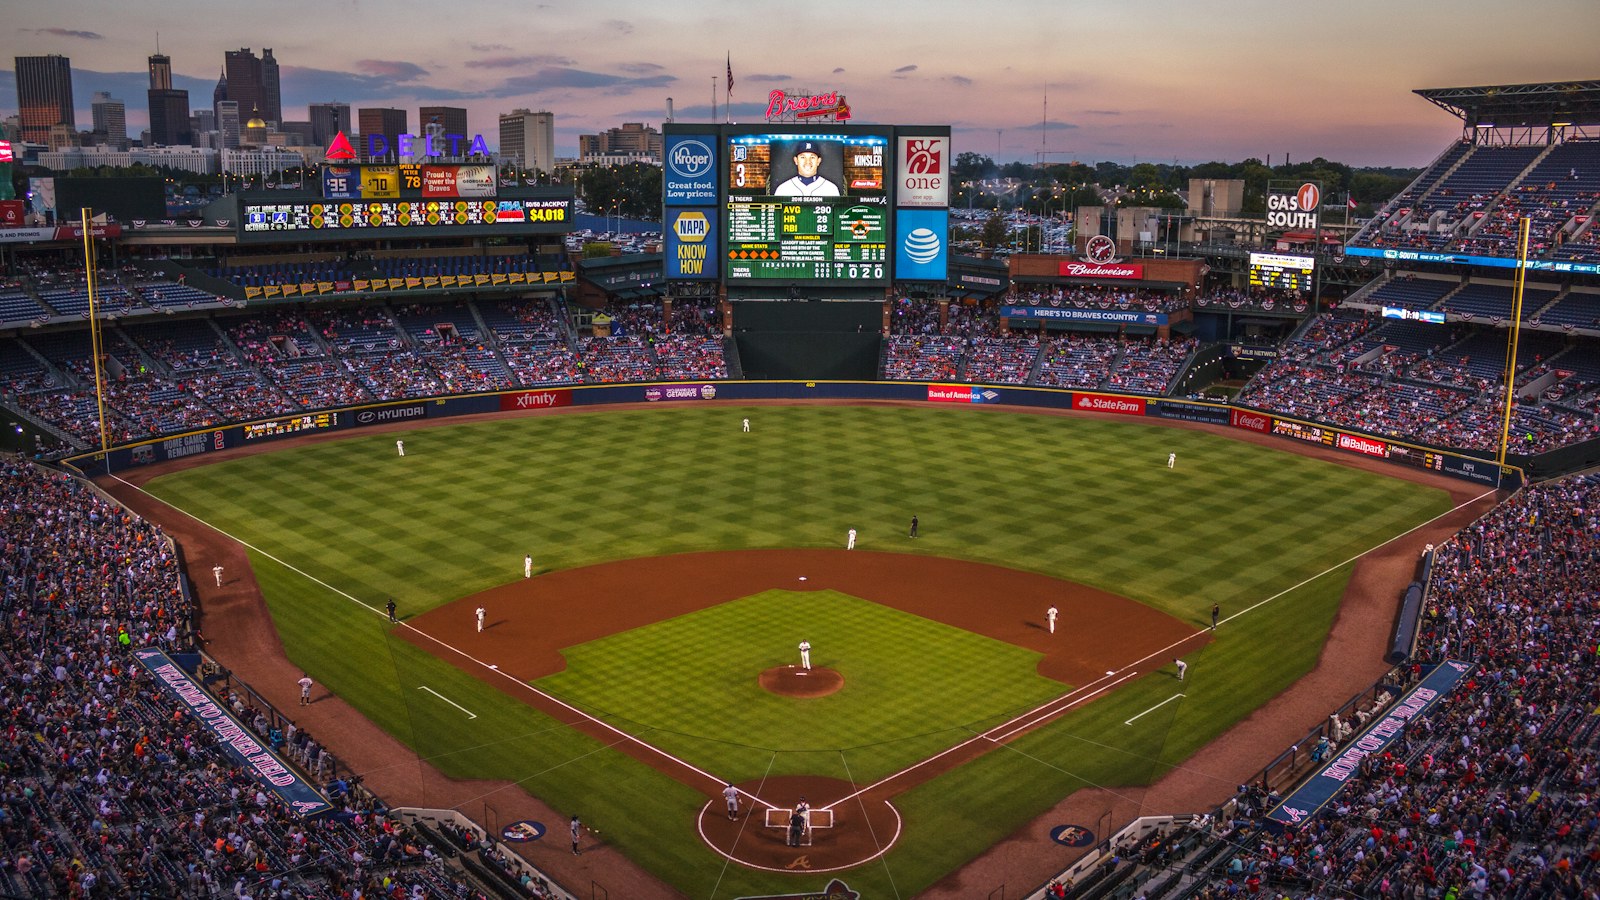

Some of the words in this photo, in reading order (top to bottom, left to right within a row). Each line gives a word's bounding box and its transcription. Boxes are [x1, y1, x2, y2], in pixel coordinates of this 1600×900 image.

[766, 90, 838, 119] Braves
[368, 133, 491, 157] DELTA
[674, 147, 708, 172] Kroger
[854, 155, 882, 166] KINSLER
[405, 176, 421, 188] 78
[736, 164, 746, 187] 3
[326, 178, 348, 192] $35
[368, 178, 388, 191] $70
[906, 178, 940, 189] one
[686, 190, 715, 199] prices.
[1268, 195, 1298, 211] GAS
[530, 209, 564, 221] $4,018
[1267, 212, 1317, 228] SOUTH
[680, 220, 704, 234] NAPA
[678, 244, 706, 259] KNOW
[1399, 251, 1418, 259] SOUTH
[680, 260, 703, 274] HOW
[849, 268, 857, 278] 0
[862, 268, 870, 278] 2
[875, 268, 882, 278] 0
[1067, 264, 1134, 276] Budweiser
[1102, 313, 1138, 321] COUNTRY
[516, 393, 556, 408] xfinity
[378, 406, 424, 420] HYUNDAI
[1312, 427, 1320, 436] 78
[164, 438, 183, 450] HOME
[184, 434, 207, 446] GAMES
[214, 430, 224, 450] 2
[1350, 438, 1384, 455] Ballpark
[167, 443, 205, 459] REMAINING
[1392, 446, 1408, 454] Kinsler
[1445, 467, 1469, 476] NORTHSIDE
[1470, 472, 1492, 482] HOSPITAL
[154, 664, 210, 706] WELCOME
[195, 702, 222, 718] TO
[208, 715, 262, 757] TURNER
[1322, 746, 1370, 781] HOME
[1356, 733, 1385, 750] OF
[1374, 716, 1405, 738] THE
[1390, 687, 1437, 720] BRAVES
[249, 753, 295, 786] FIELD
